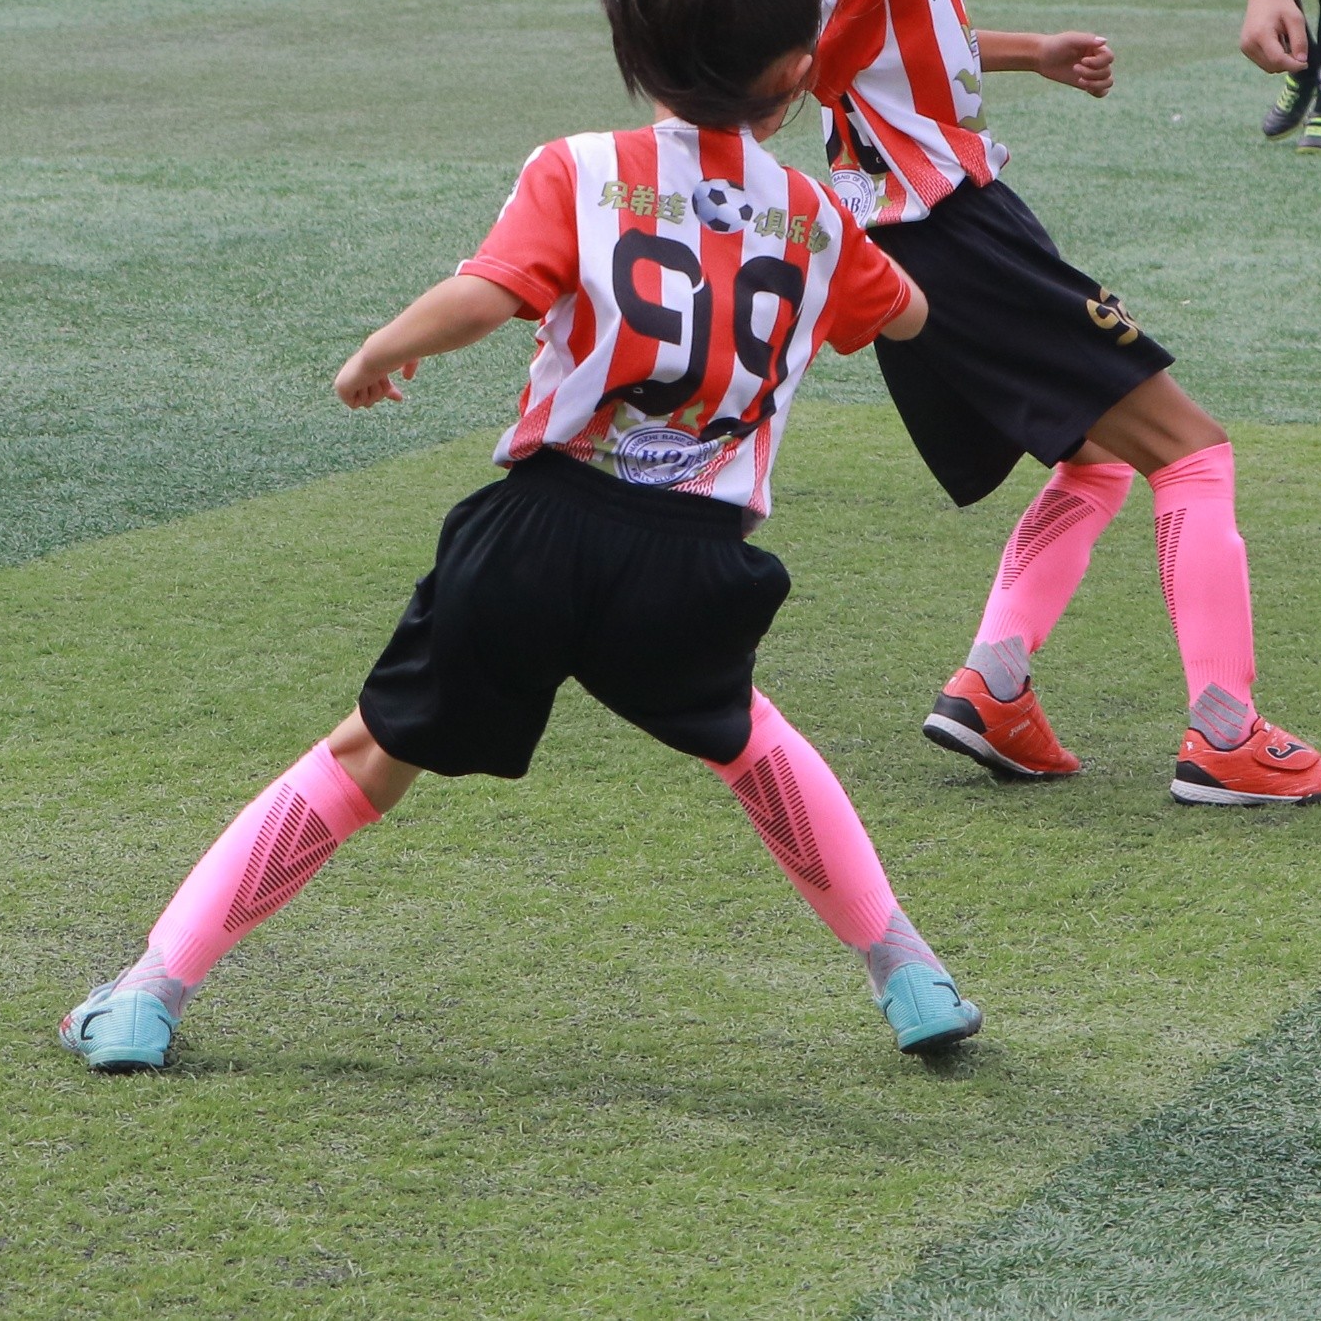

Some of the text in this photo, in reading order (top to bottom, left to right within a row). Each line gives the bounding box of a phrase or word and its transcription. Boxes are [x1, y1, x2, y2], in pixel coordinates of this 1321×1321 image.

[597, 180, 832, 254] 兄弟连 俱乐部
[594, 227, 804, 441] 99
